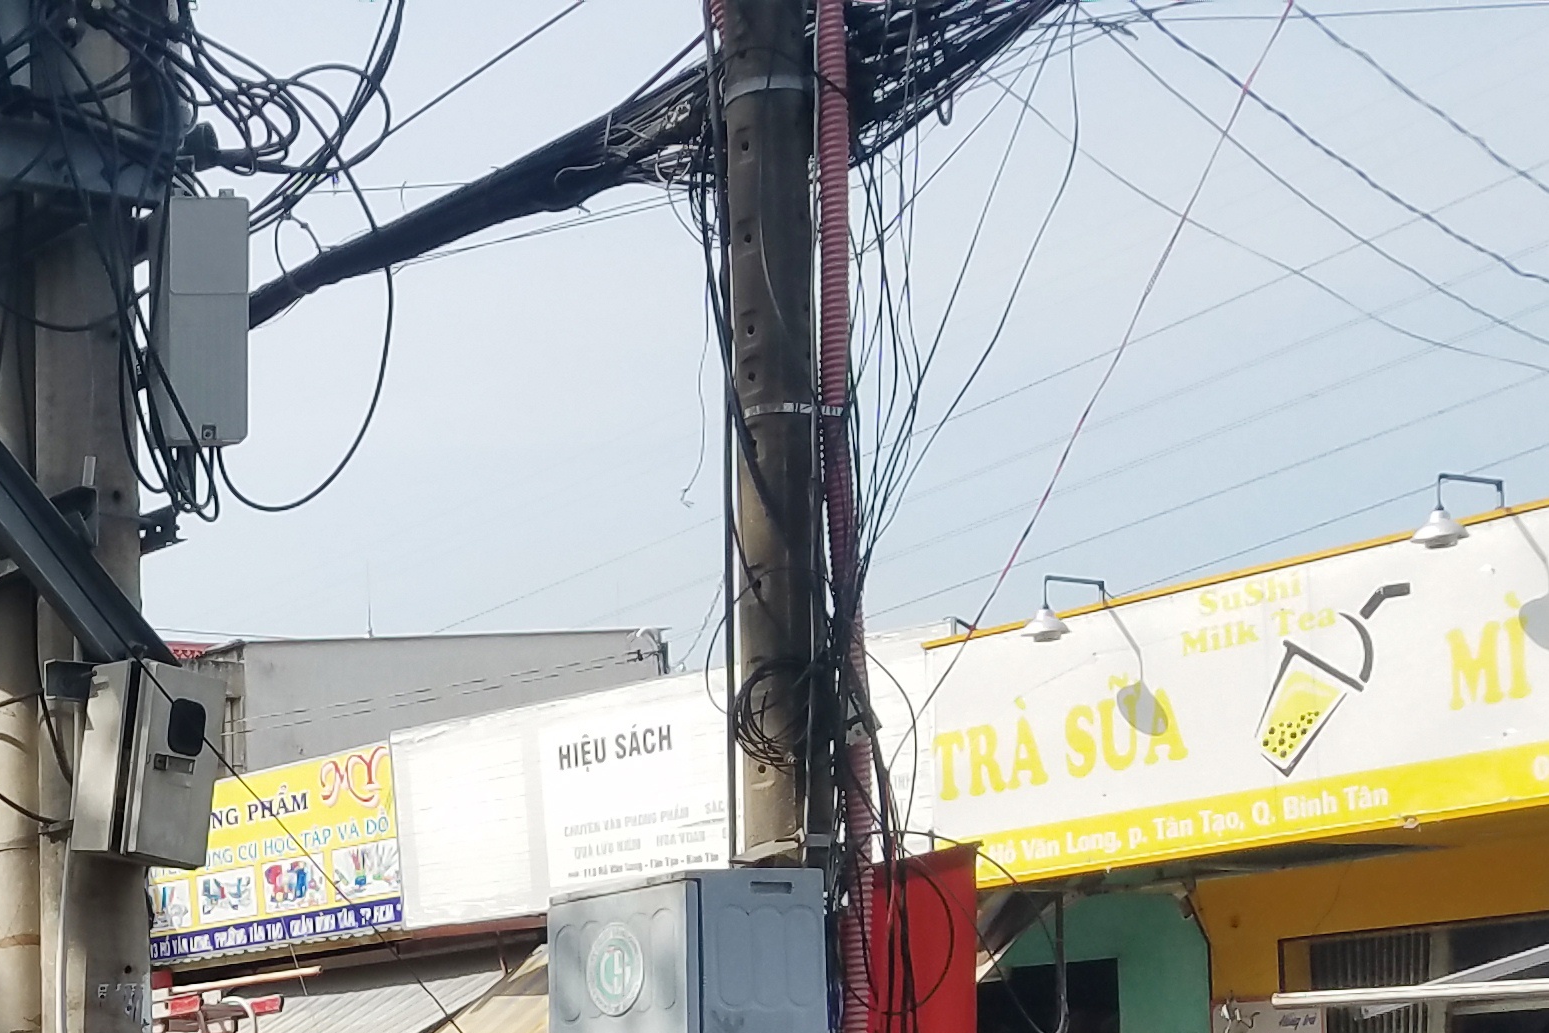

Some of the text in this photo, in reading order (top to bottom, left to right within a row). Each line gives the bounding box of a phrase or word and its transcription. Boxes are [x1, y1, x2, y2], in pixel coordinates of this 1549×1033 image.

[1199, 572, 1301, 616] SuShi
[1180, 607, 1337, 657] Milk Tea
[1445, 590, 1533, 711] MÌ
[558, 723, 673, 773] HIỆU SÁCH
[933, 672, 1189, 801] TRÀ SỮA
[211, 784, 309, 830] NG PHẨM
[1065, 831, 1122, 853] Long,
[1152, 817, 1194, 841] Tân
[1251, 800, 1276, 825] Q.
[1342, 785, 1389, 809] Tân
